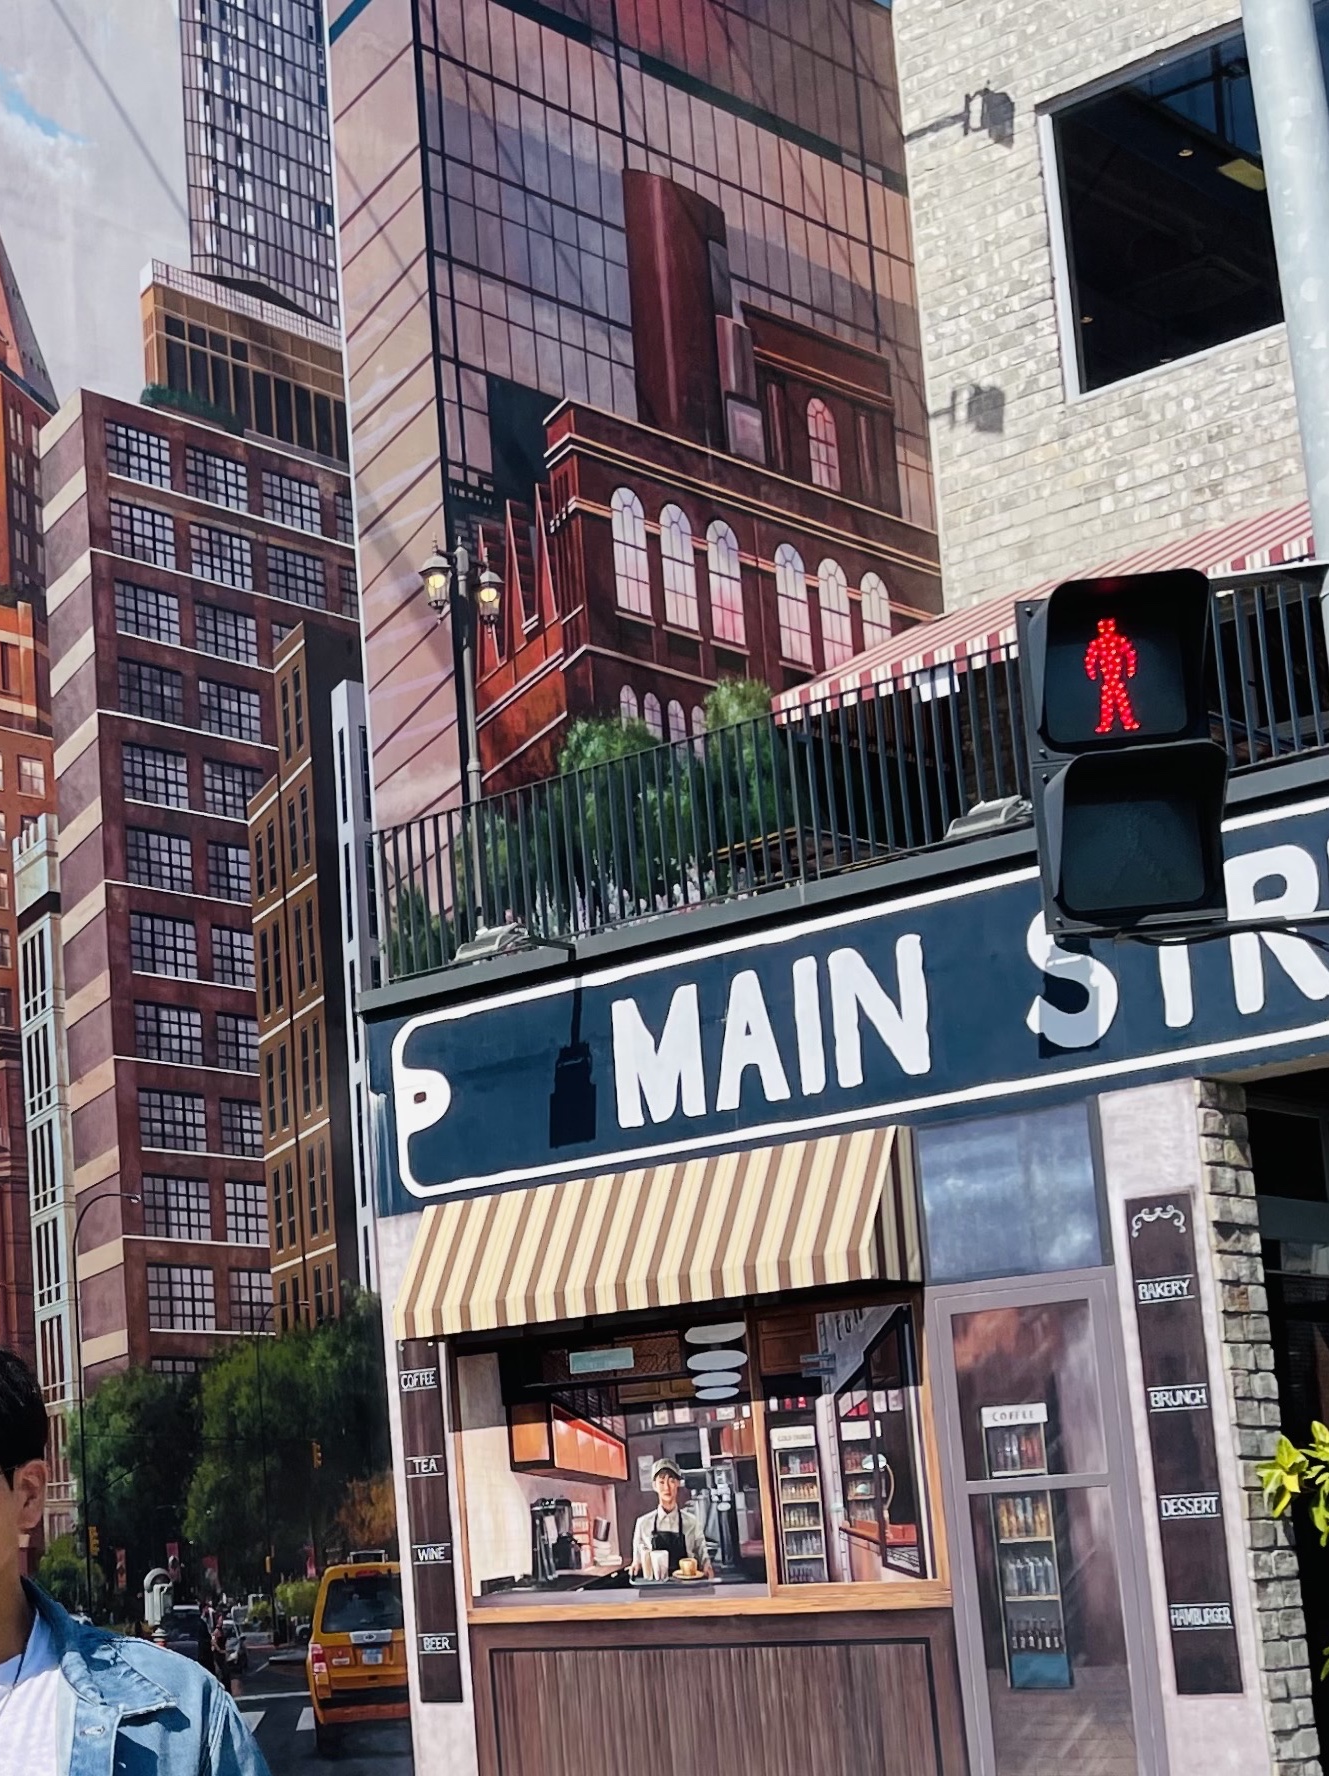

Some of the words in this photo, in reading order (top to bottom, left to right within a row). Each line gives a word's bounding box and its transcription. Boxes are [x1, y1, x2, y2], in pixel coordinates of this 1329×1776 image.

[611, 934, 930, 1128] MAIN
[1138, 1279, 1191, 1300] BAKERY
[400, 1370, 436, 1390] COFFEE
[1150, 1388, 1207, 1407] BRUNCH
[413, 1458, 438, 1473] TEA
[1161, 1496, 1218, 1516] DESSERT
[417, 1546, 445, 1561] WINE
[1170, 1606, 1232, 1626] HAMBURGER
[423, 1636, 450, 1651] BEER
